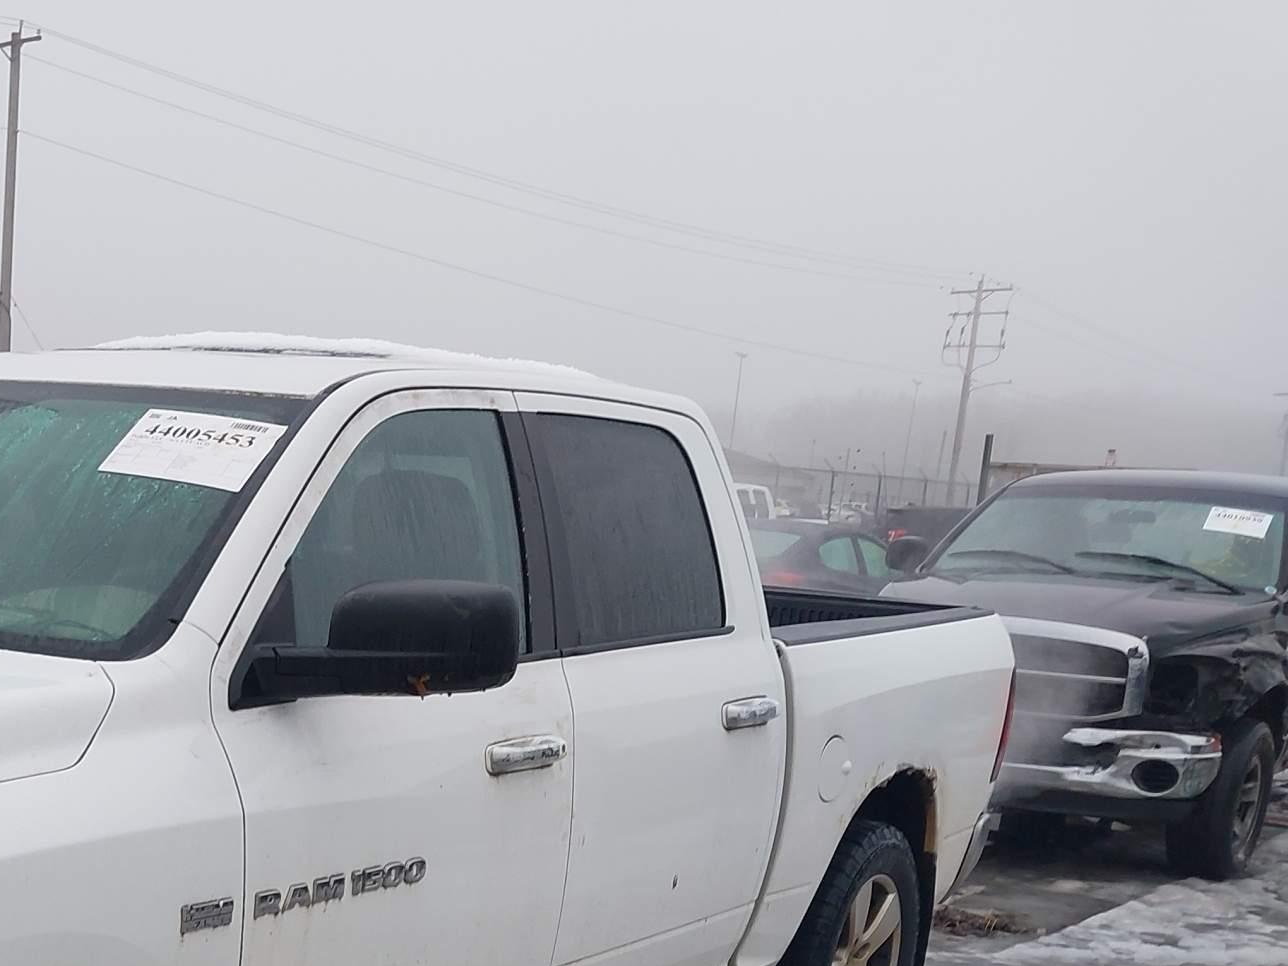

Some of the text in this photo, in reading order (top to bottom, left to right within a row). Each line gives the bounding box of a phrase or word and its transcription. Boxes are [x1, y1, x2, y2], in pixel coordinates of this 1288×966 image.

[144, 423, 257, 448] 44005453
[253, 872, 346, 920] RAM
[350, 856, 427, 897] 1500
